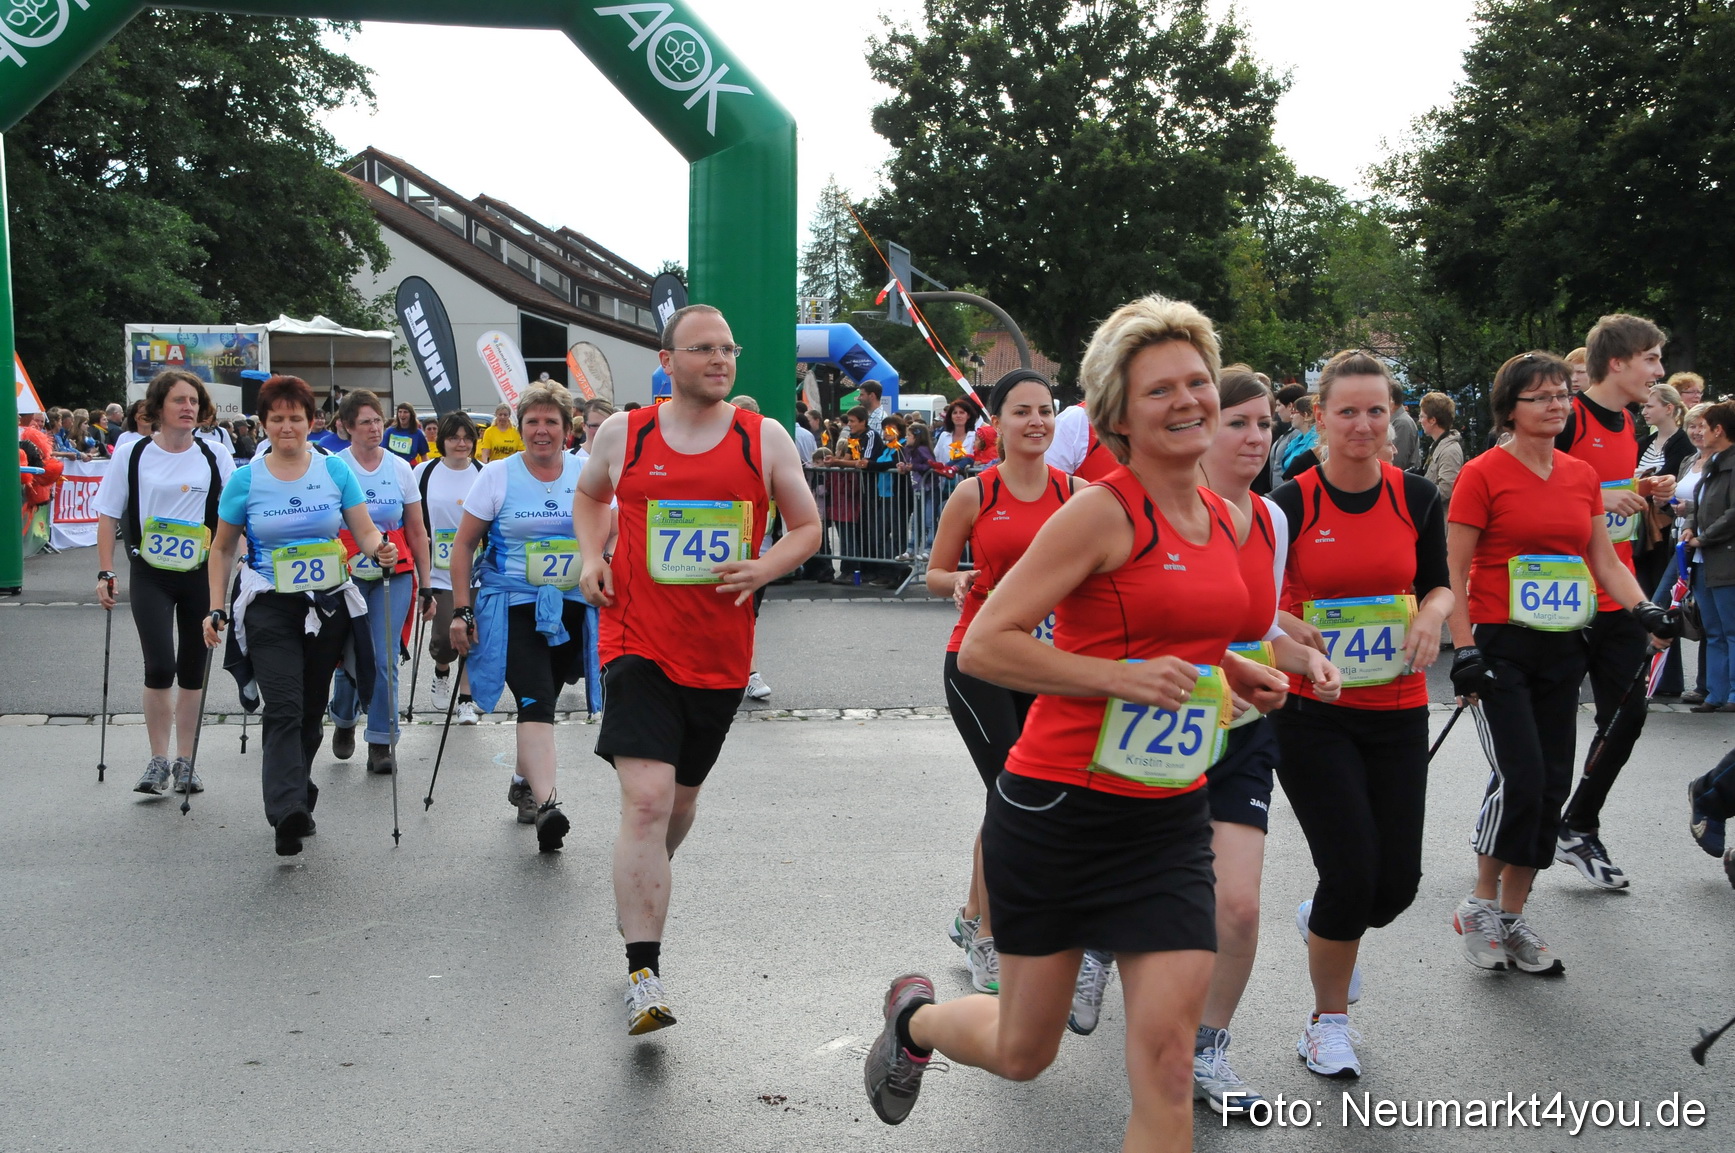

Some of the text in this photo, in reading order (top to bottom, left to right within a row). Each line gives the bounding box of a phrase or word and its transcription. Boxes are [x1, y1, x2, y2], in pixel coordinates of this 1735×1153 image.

[593, 3, 755, 137] AOK
[137, 345, 183, 361] TLA
[58, 480, 101, 520] MEIE
[148, 533, 195, 560] 326
[659, 530, 731, 563] 745
[1314, 536, 1336, 544] erima
[291, 558, 326, 585] 28
[542, 554, 575, 577] 27
[661, 563, 696, 573] Stephan
[1163, 563, 1187, 572] erima
[1520, 581, 1582, 612] 644
[1533, 612, 1557, 621] Margit
[1320, 626, 1397, 663] 744
[1337, 666, 1357, 675] atja
[1118, 703, 1206, 757] 725
[1125, 754, 1163, 768] Kristin
